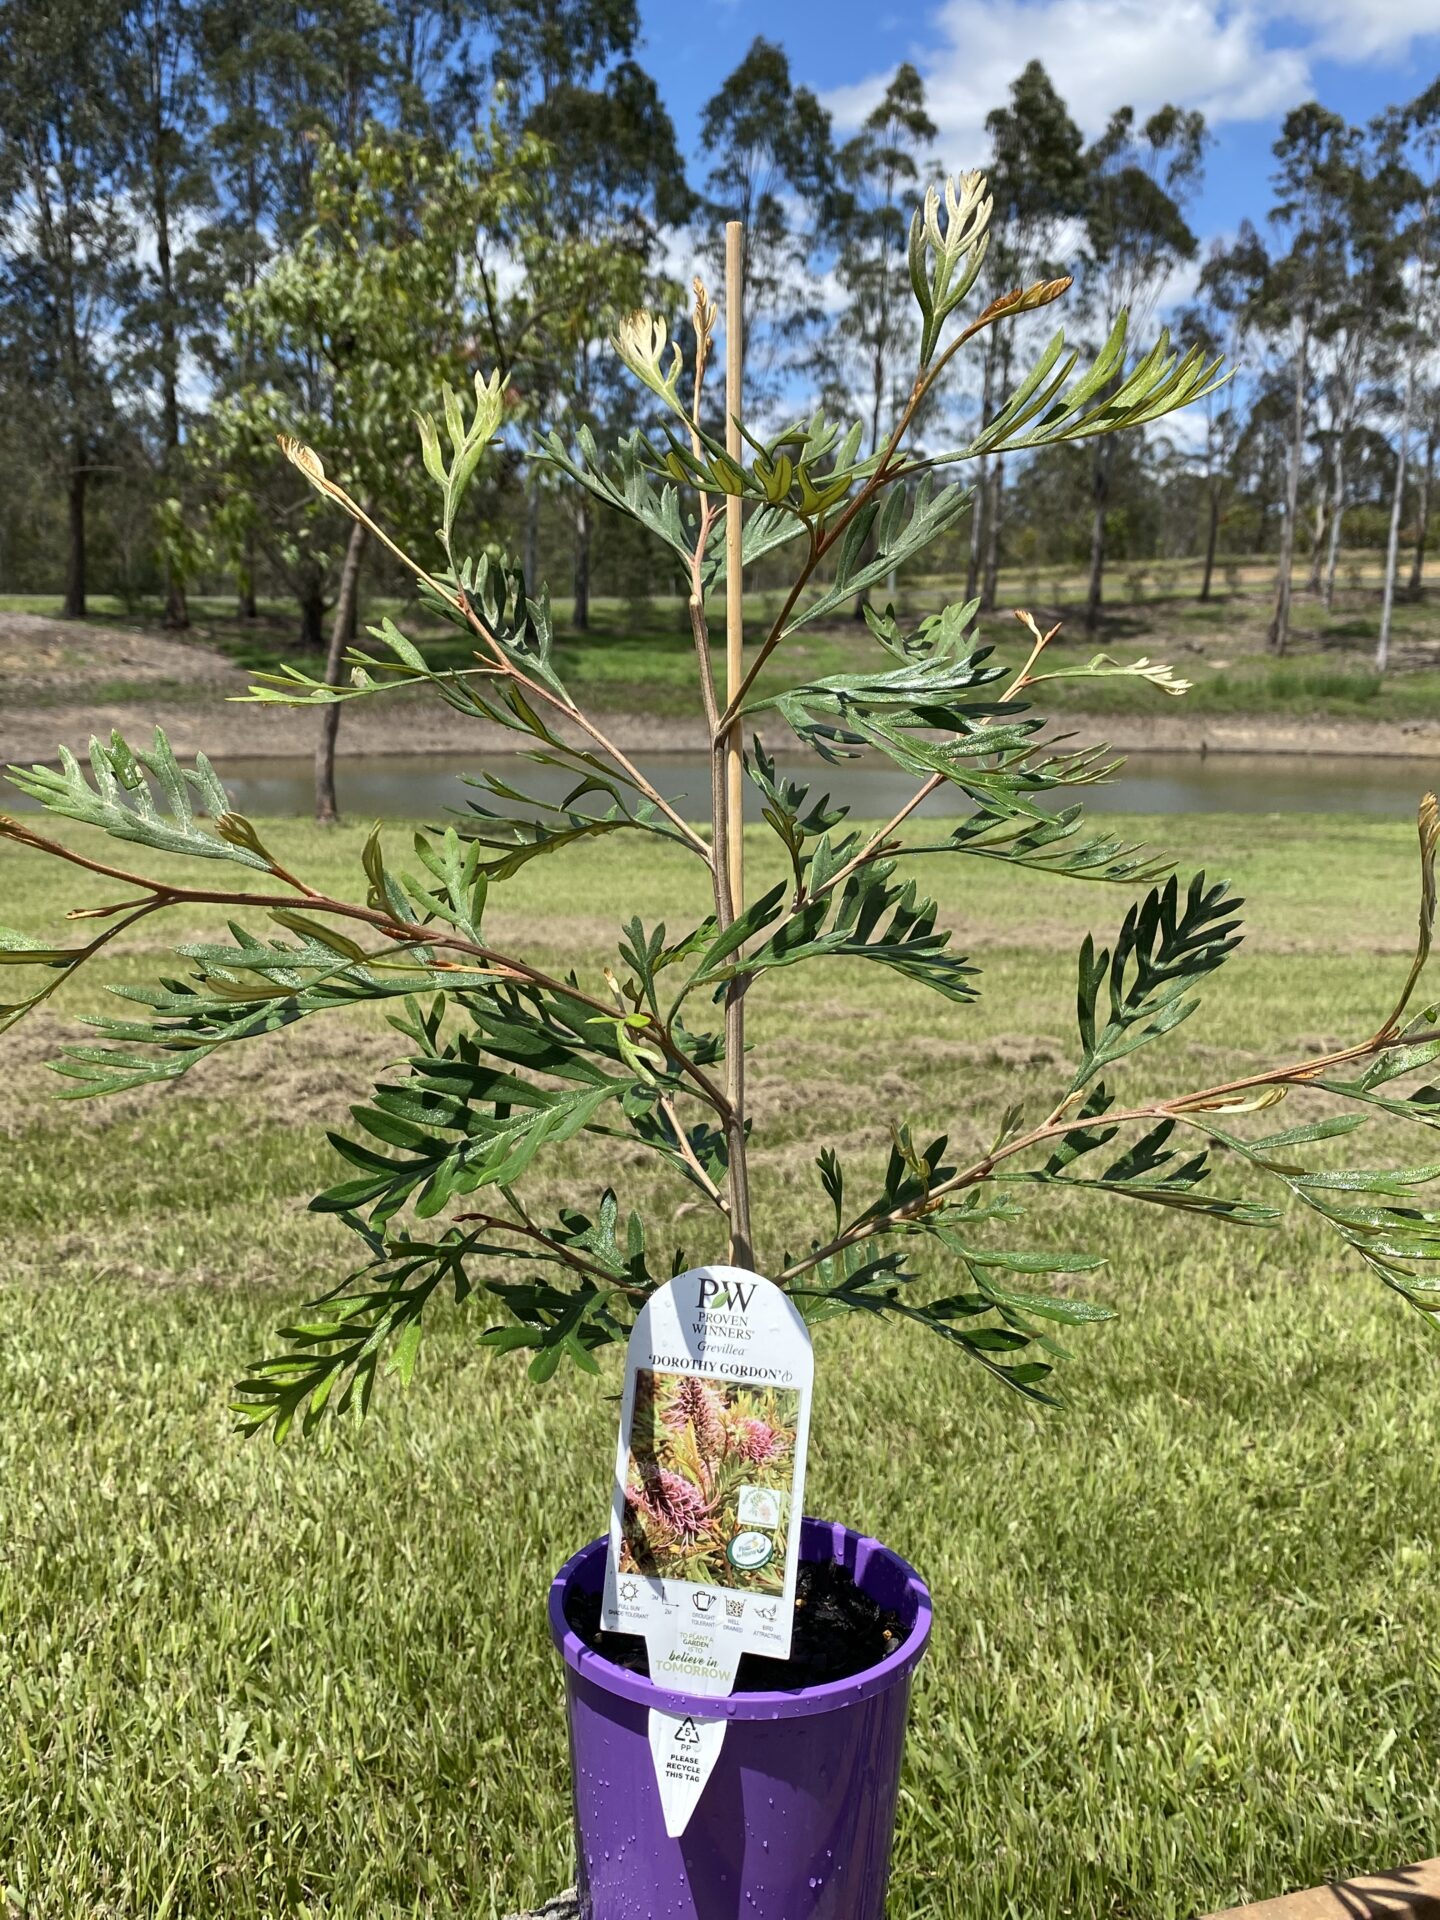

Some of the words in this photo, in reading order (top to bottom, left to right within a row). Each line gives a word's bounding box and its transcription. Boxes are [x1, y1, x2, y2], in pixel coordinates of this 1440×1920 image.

[698, 1311, 749, 1327] PROVEN
[697, 1340, 745, 1356] Grevillea
[618, 1603, 629, 1611] FULL
[608, 1609, 624, 1617] SHADE
[625, 1611, 649, 1619] TOLERANT
[691, 1612, 716, 1621] DROUGHT
[691, 1619, 715, 1628] TOLERANT
[727, 1618, 740, 1626] WELL
[723, 1624, 744, 1633] DRAINED
[689, 1633, 708, 1642] PLANT
[753, 1630, 782, 1641] ATTRACTING
[682, 1639, 709, 1649] GARDEN
[668, 1650, 705, 1665] believe
[706, 1656, 718, 1668] in
[655, 1660, 731, 1681] TOMORROW
[684, 1727, 691, 1737] 5
[680, 1743, 692, 1751] PP
[670, 1753, 699, 1765] PLEASE
[666, 1762, 701, 1774] RECYCLE
[665, 1770, 683, 1779] THIS
[685, 1773, 700, 1783] TAG
